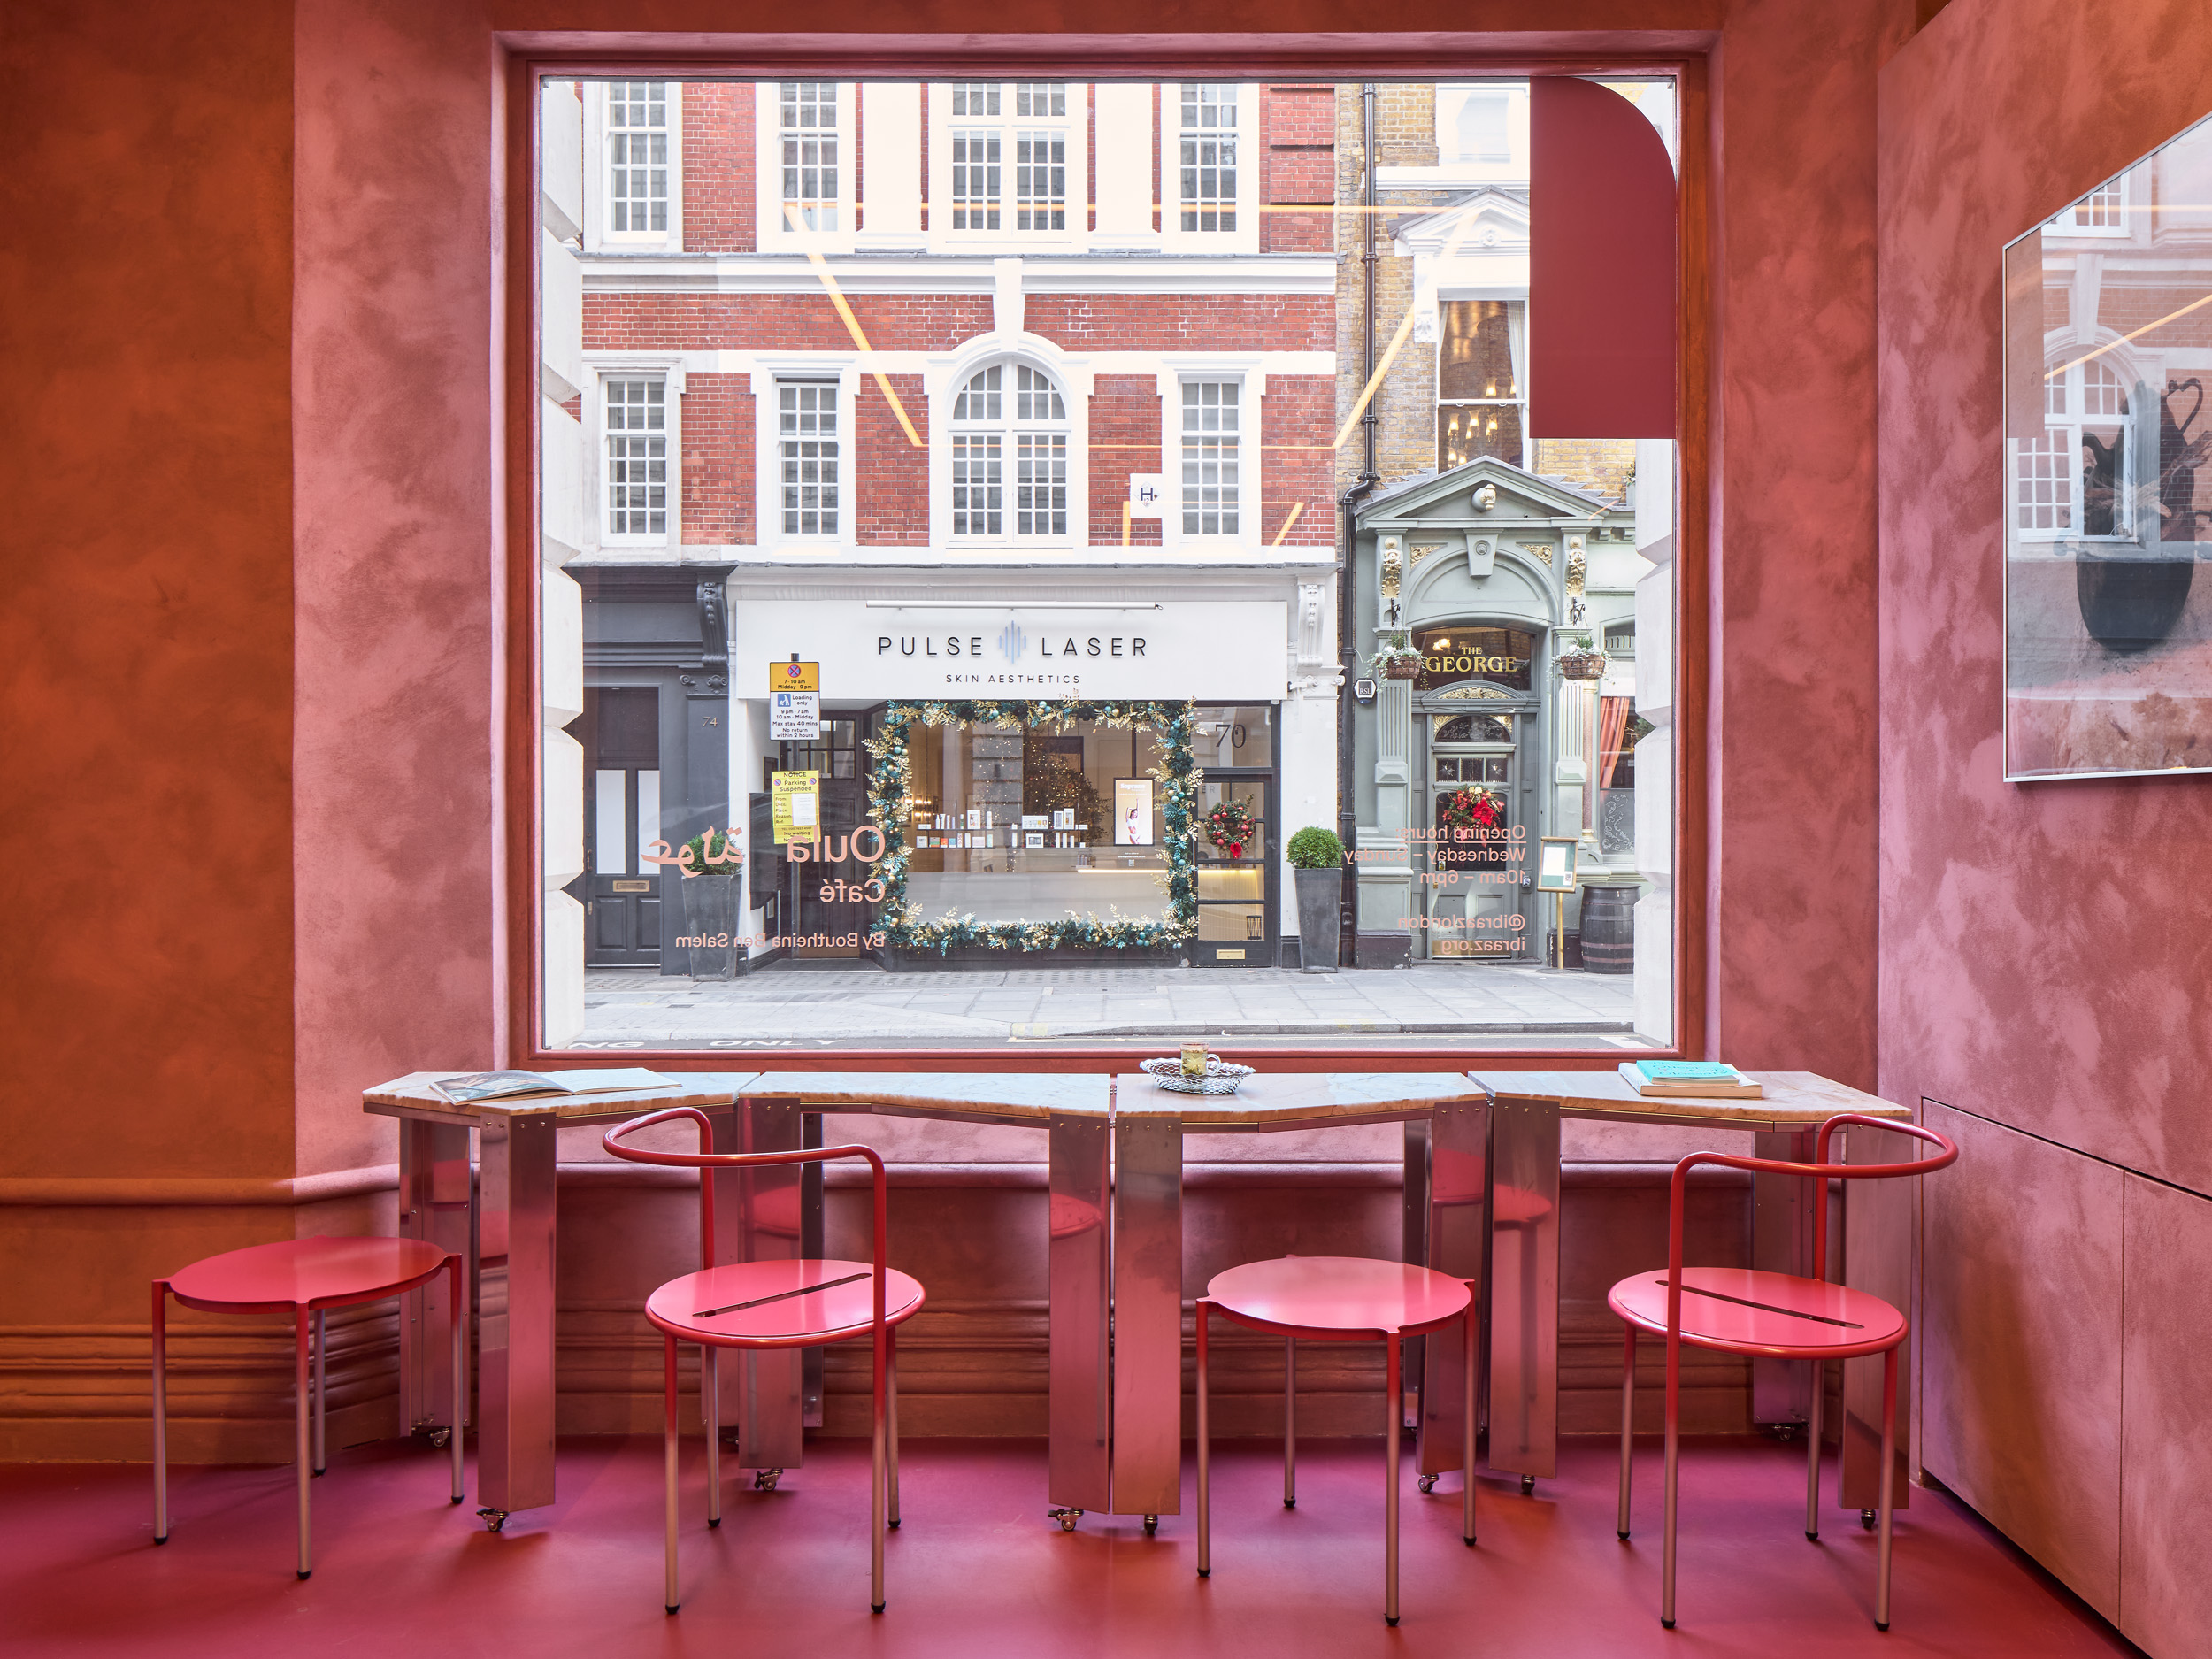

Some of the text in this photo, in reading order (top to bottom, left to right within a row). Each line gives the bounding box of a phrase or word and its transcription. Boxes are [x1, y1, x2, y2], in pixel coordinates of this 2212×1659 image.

[878, 636, 1147, 657] PULSE LASER
[1425, 657, 1518, 672] GEORGE
[946, 674, 1080, 684] SKIN AESTHETICS
[703, 716, 718, 727] 74
[1215, 724, 1246, 748] 70
